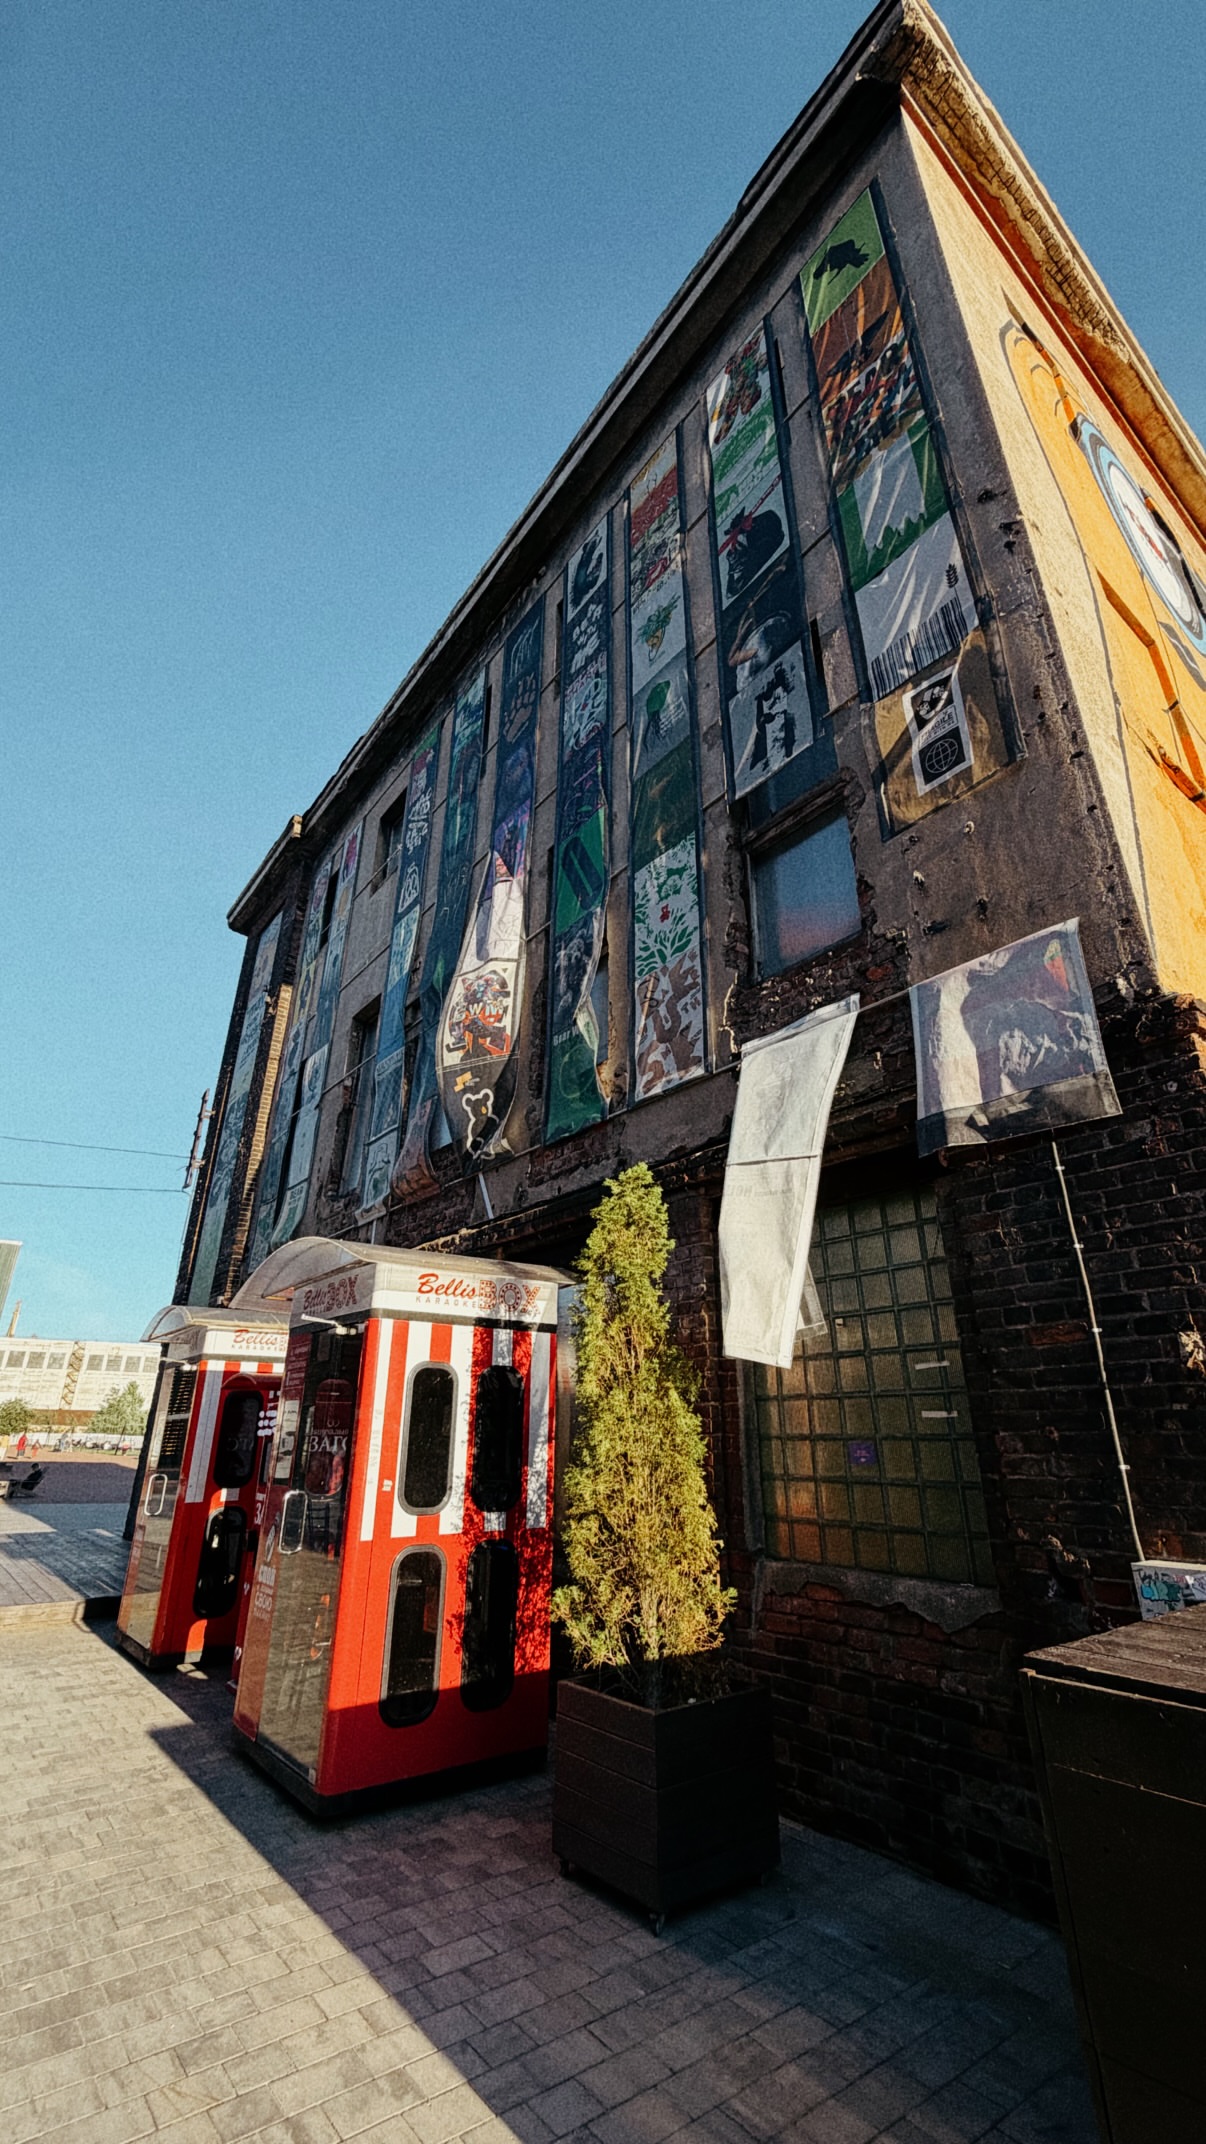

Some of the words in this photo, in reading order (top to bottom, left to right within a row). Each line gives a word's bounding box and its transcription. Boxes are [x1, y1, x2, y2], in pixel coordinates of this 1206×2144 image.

[417, 1272, 477, 1300] Bellis
[478, 1279, 542, 1314] BOX
[415, 1296, 477, 1309] KARAOKE
[233, 1329, 279, 1344] Bellis
